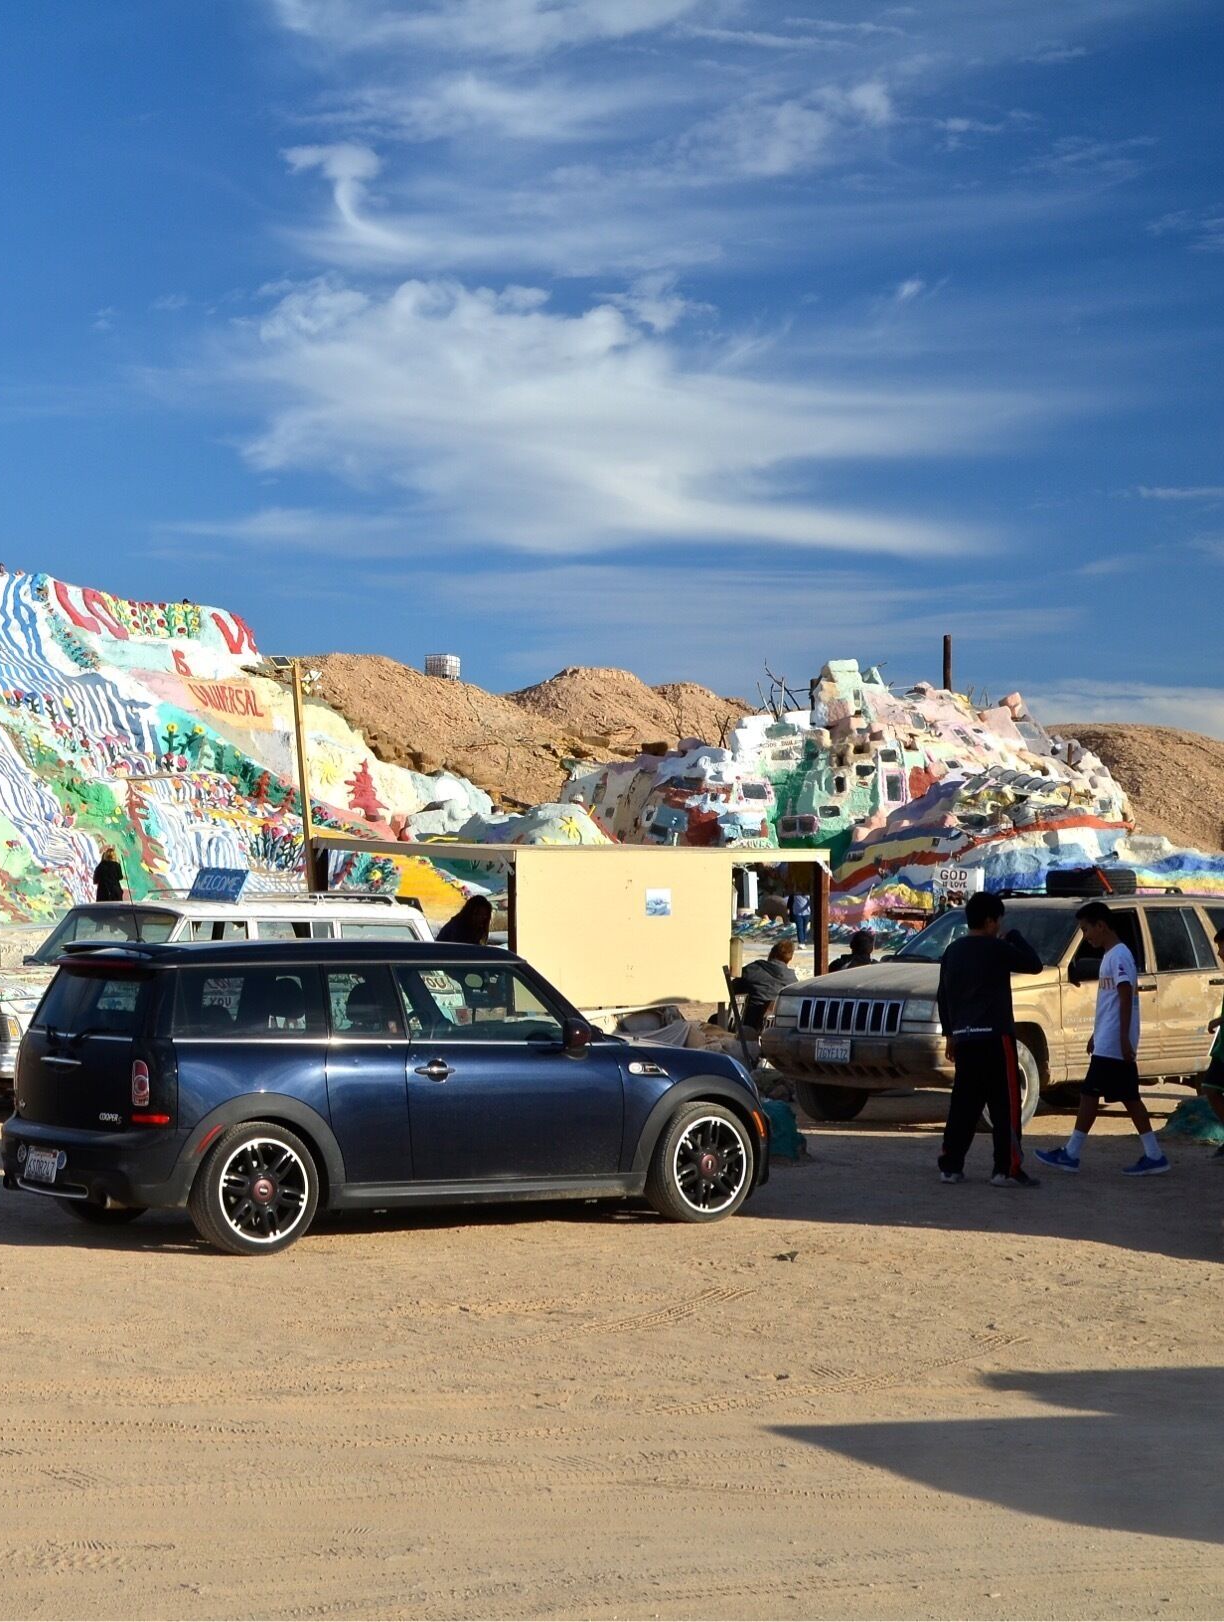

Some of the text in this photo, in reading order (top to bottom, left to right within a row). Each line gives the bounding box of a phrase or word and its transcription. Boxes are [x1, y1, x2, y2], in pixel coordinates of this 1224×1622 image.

[188, 683, 264, 717] UNIVERSAL
[940, 869, 968, 881] GOD
[194, 874, 242, 893] WELCOME
[99, 1112, 119, 1122] COOPER
